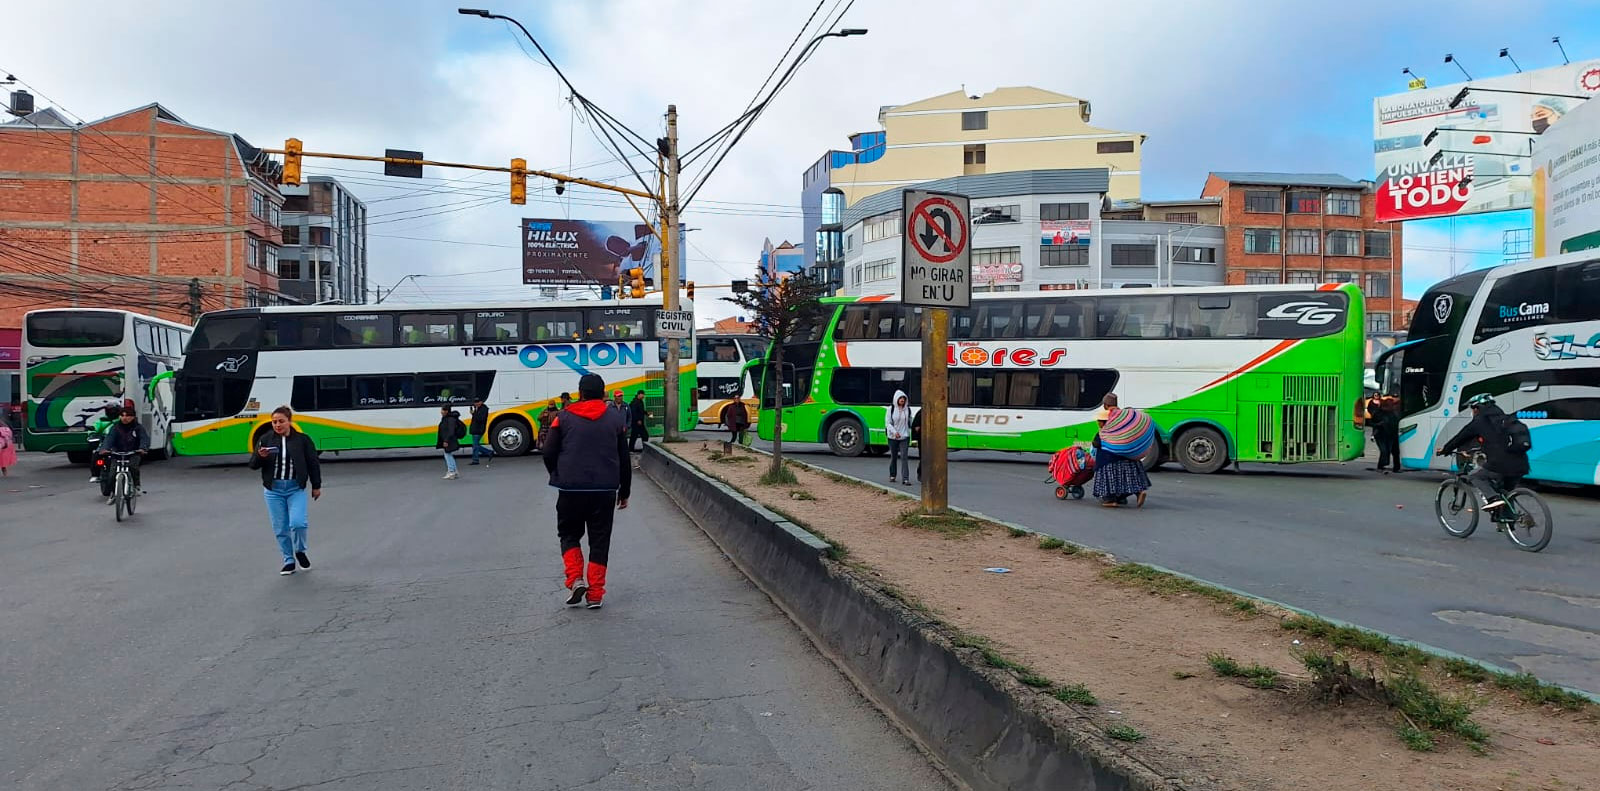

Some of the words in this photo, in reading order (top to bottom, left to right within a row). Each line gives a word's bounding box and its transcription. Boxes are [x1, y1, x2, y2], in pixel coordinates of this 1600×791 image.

[1381, 108, 1426, 121] IMPULSAN
[1426, 105, 1436, 115] TU
[1439, 99, 1477, 113] TANTO
[1387, 154, 1475, 177] UNIVALLE
[1388, 175, 1414, 191] LO
[1417, 166, 1475, 187] TIENE
[1389, 181, 1475, 210] TODO
[527, 230, 579, 242] HILUX
[911, 265, 926, 280] NO
[930, 267, 964, 283] GIRAR
[943, 284, 954, 301] U
[656, 310, 692, 322] REGISTRO
[661, 321, 686, 332] CIVIL
[461, 345, 518, 357] TRANS
[518, 342, 643, 376] ORION
[951, 413, 1010, 425] LEITO
